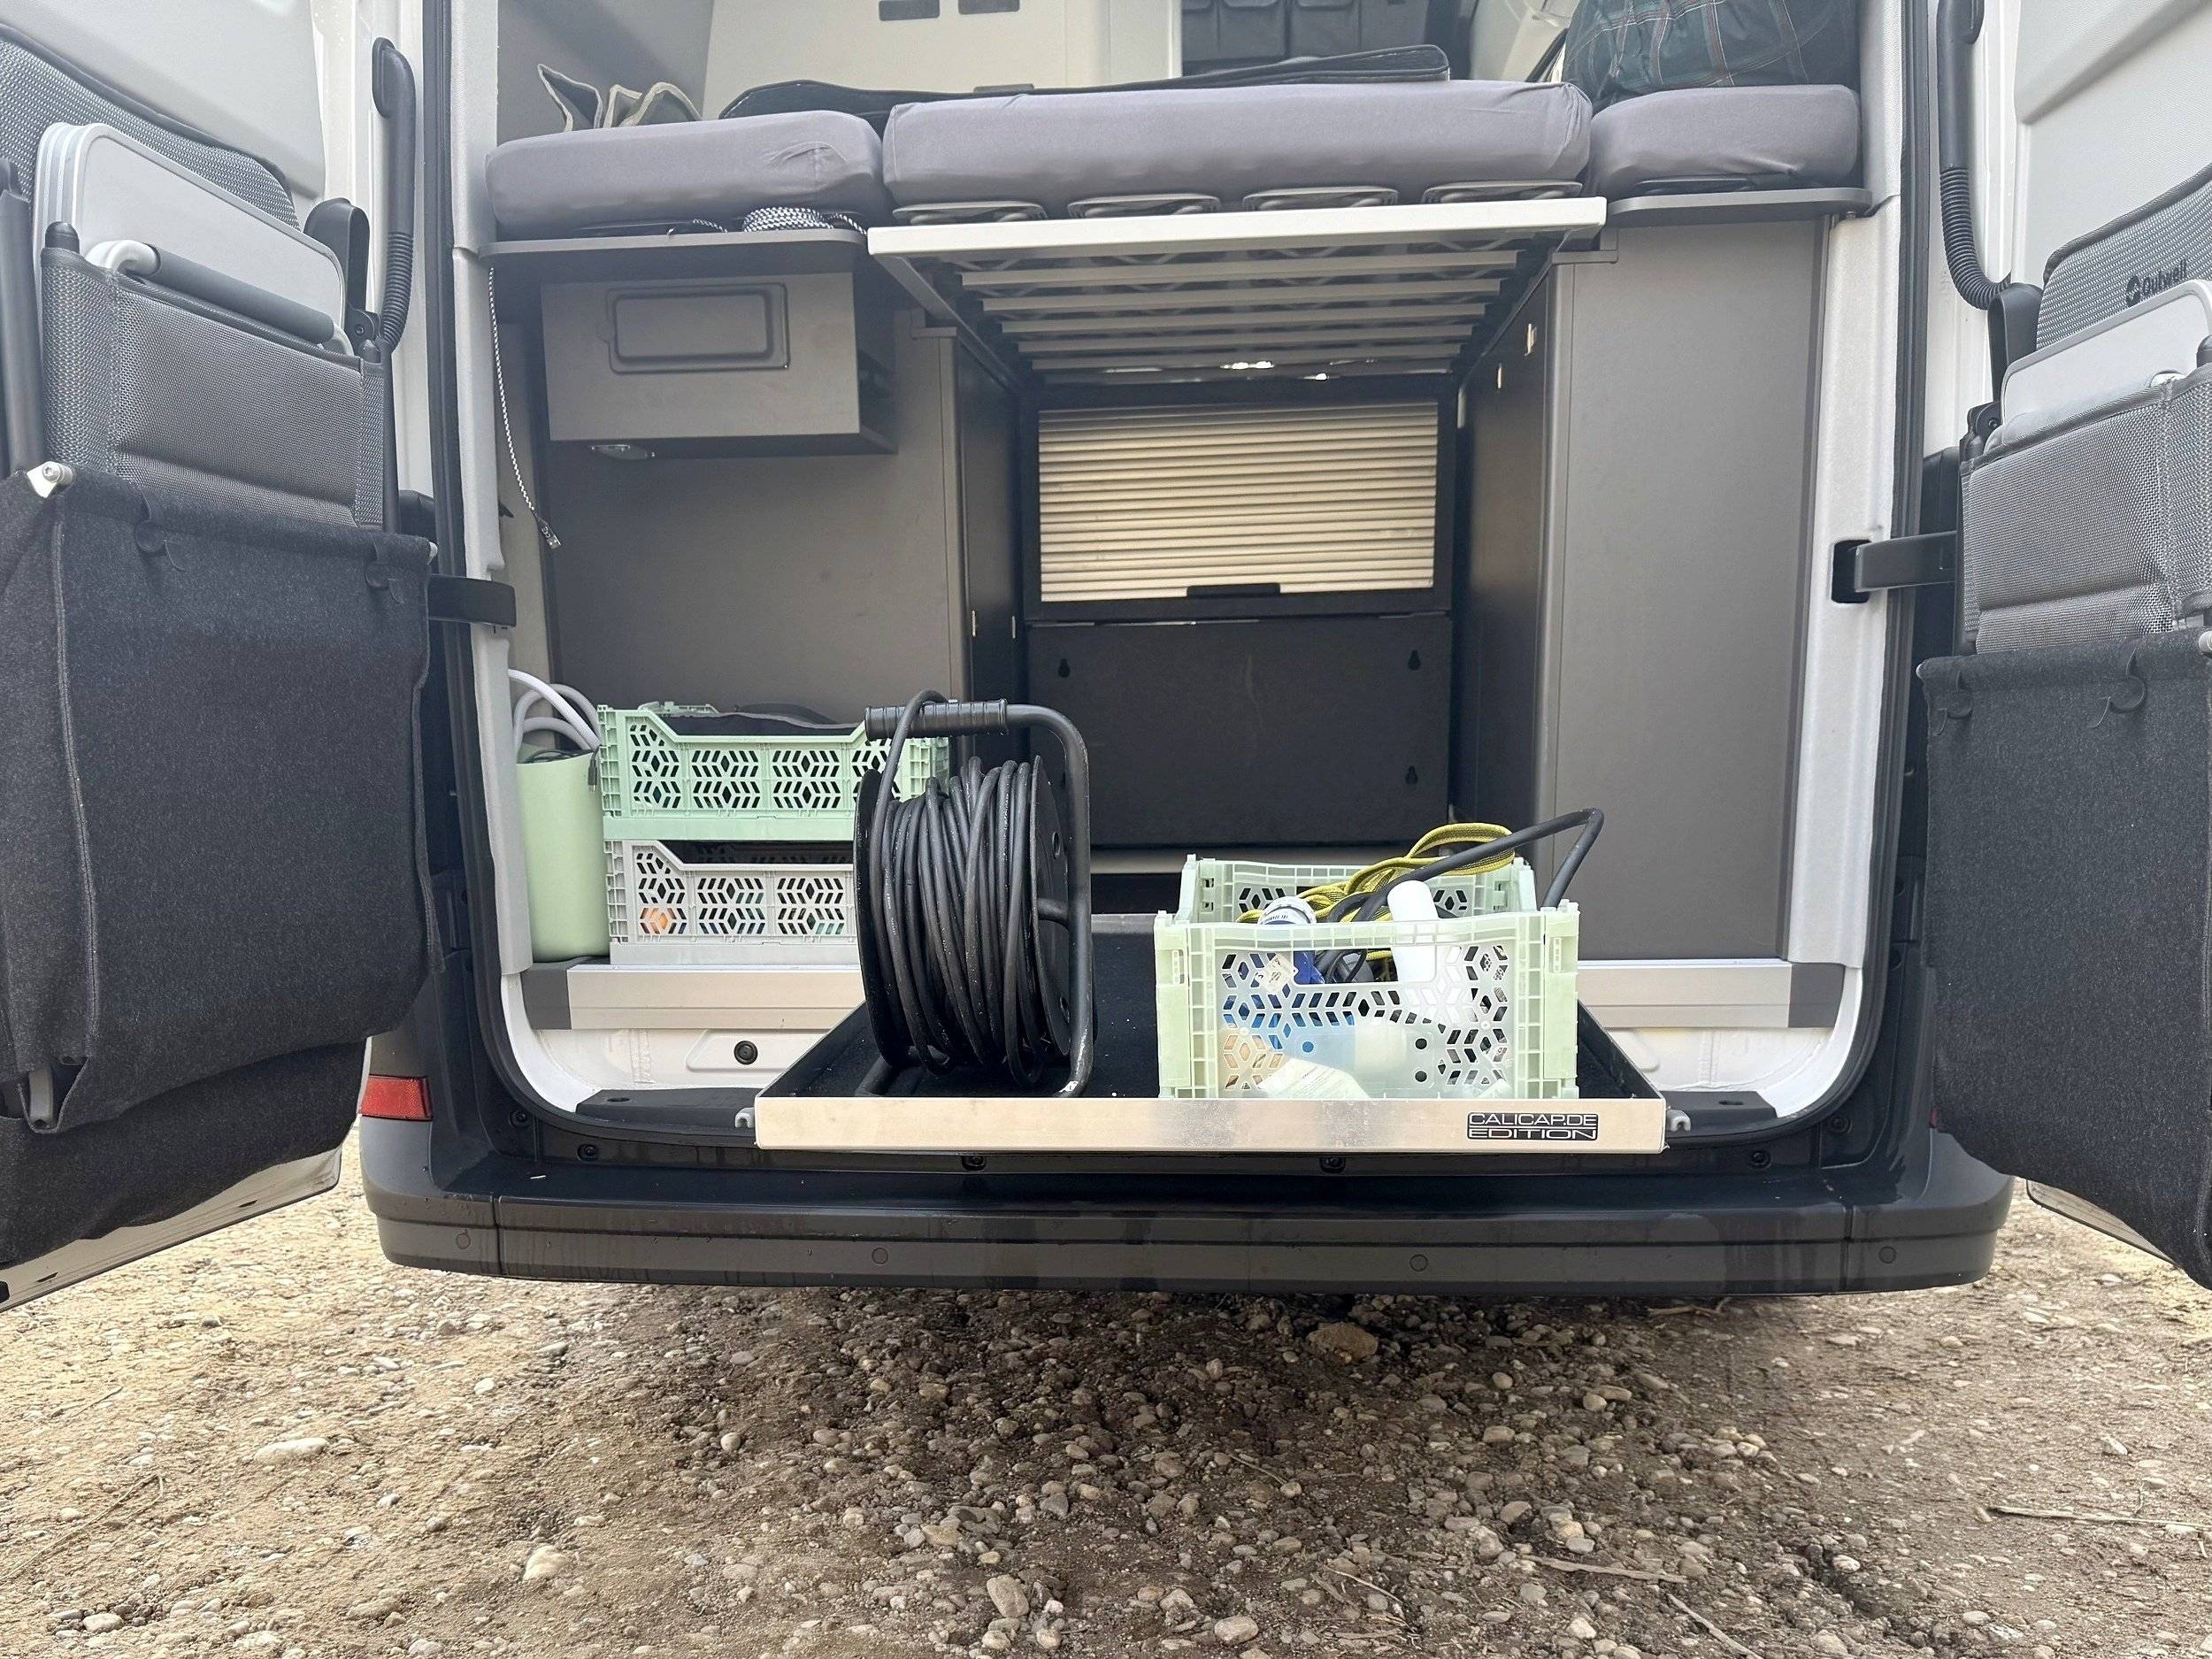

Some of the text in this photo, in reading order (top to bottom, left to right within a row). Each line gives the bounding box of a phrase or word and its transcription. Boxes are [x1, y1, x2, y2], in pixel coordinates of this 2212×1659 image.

[2142, 258, 2187, 296] Outwell
[1469, 1113, 1597, 1126] CALICAP.DE
[1469, 1128, 1596, 1140] EDITION
